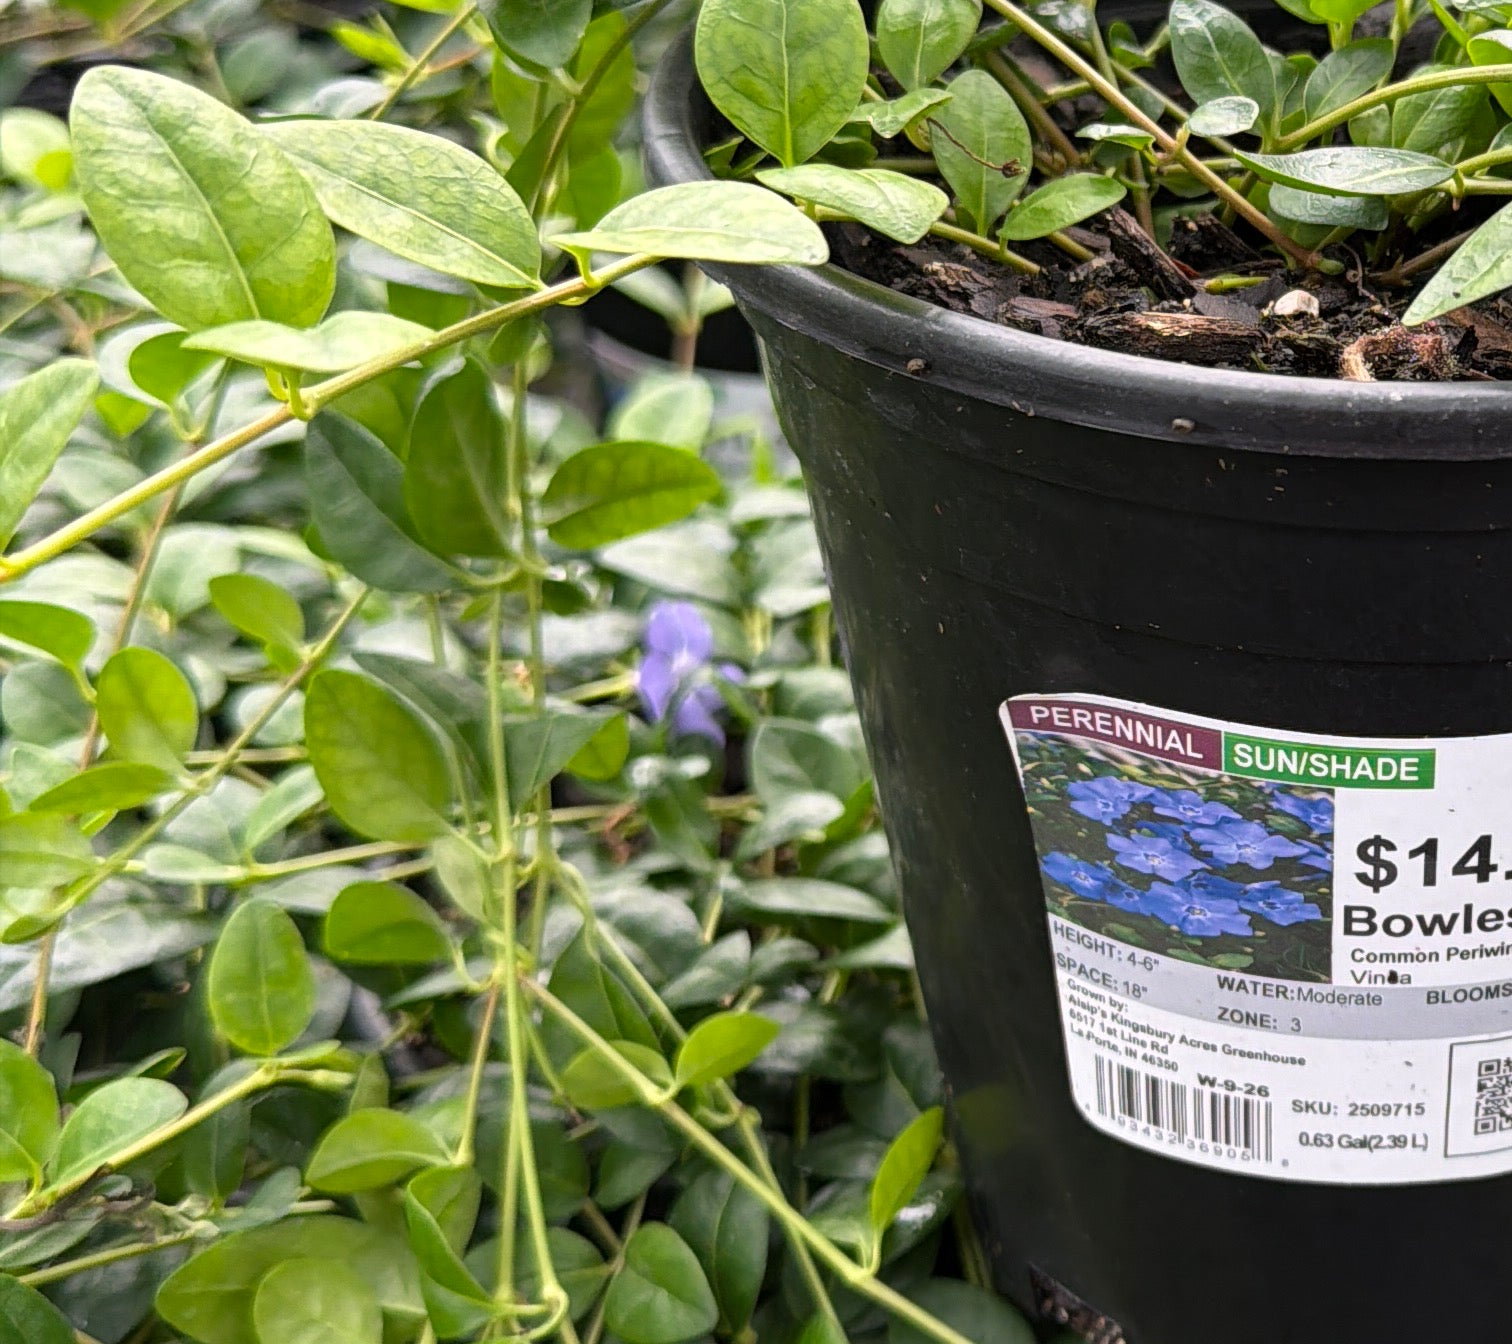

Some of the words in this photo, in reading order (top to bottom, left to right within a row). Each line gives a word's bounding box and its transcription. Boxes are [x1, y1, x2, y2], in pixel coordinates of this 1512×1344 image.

[1030, 705, 1203, 759] PERENNIAL
[1233, 743, 1419, 781] SUN/SHADE
[1053, 920, 1122, 962] HEIGHT:
[1127, 951, 1160, 972] 4-6"
[1350, 947, 1440, 963] Common
[1056, 952, 1118, 991] SPACE:
[1123, 980, 1148, 999] 18"
[1350, 969, 1412, 985] Vina
[1067, 978, 1106, 1004] Grown
[1109, 996, 1128, 1013] by:
[1217, 974, 1294, 1001] WATER:
[1298, 987, 1383, 1006] Moderate
[1217, 1006, 1277, 1030] ZONE:
[1290, 1017, 1302, 1033] 3
[1111, 1012, 1175, 1044] Kingsbury
[1179, 1034, 1218, 1053] Acres
[1222, 1043, 1306, 1066] Greenhouse
[1121, 1029, 1148, 1049] Line
[1150, 1040, 1169, 1055] Rd
[1125, 1046, 1138, 1059] IN
[1141, 1052, 1179, 1072] 46350
[1196, 1072, 1271, 1098] W-9-26
[1291, 1099, 1339, 1116] SKU:
[1347, 1102, 1426, 1117] 2509715
[1298, 1131, 1334, 1148] 0.63
[1411, 1133, 1429, 1152] L)
